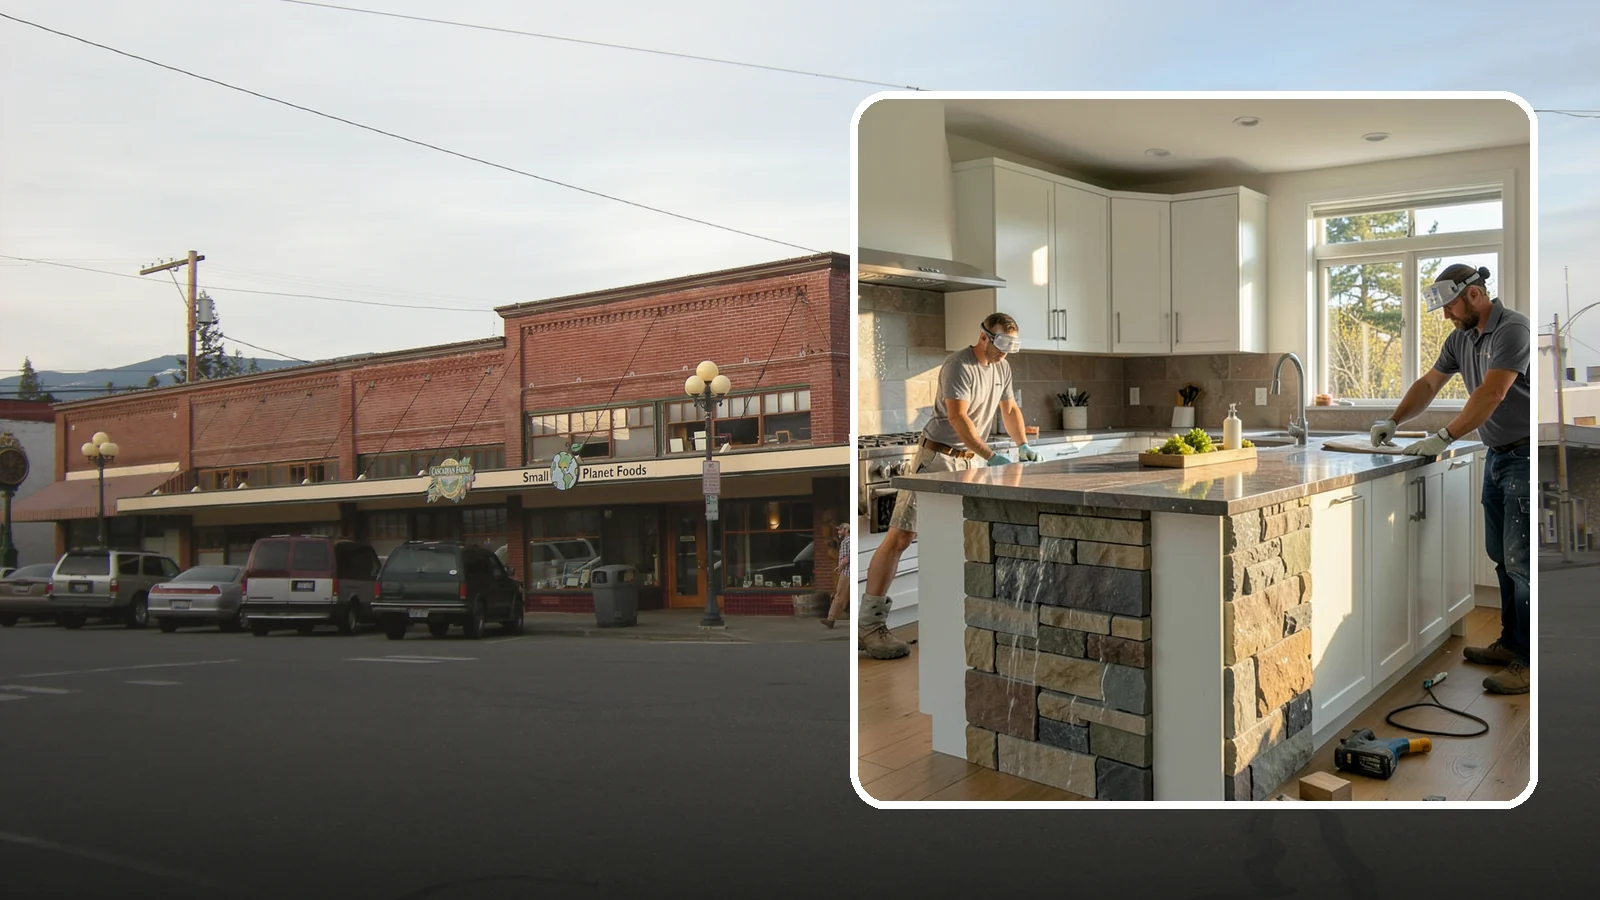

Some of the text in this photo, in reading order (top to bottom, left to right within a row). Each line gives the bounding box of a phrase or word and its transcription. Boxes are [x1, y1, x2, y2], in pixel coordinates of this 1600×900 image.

[523, 464, 647, 483] Small Planet Foods
